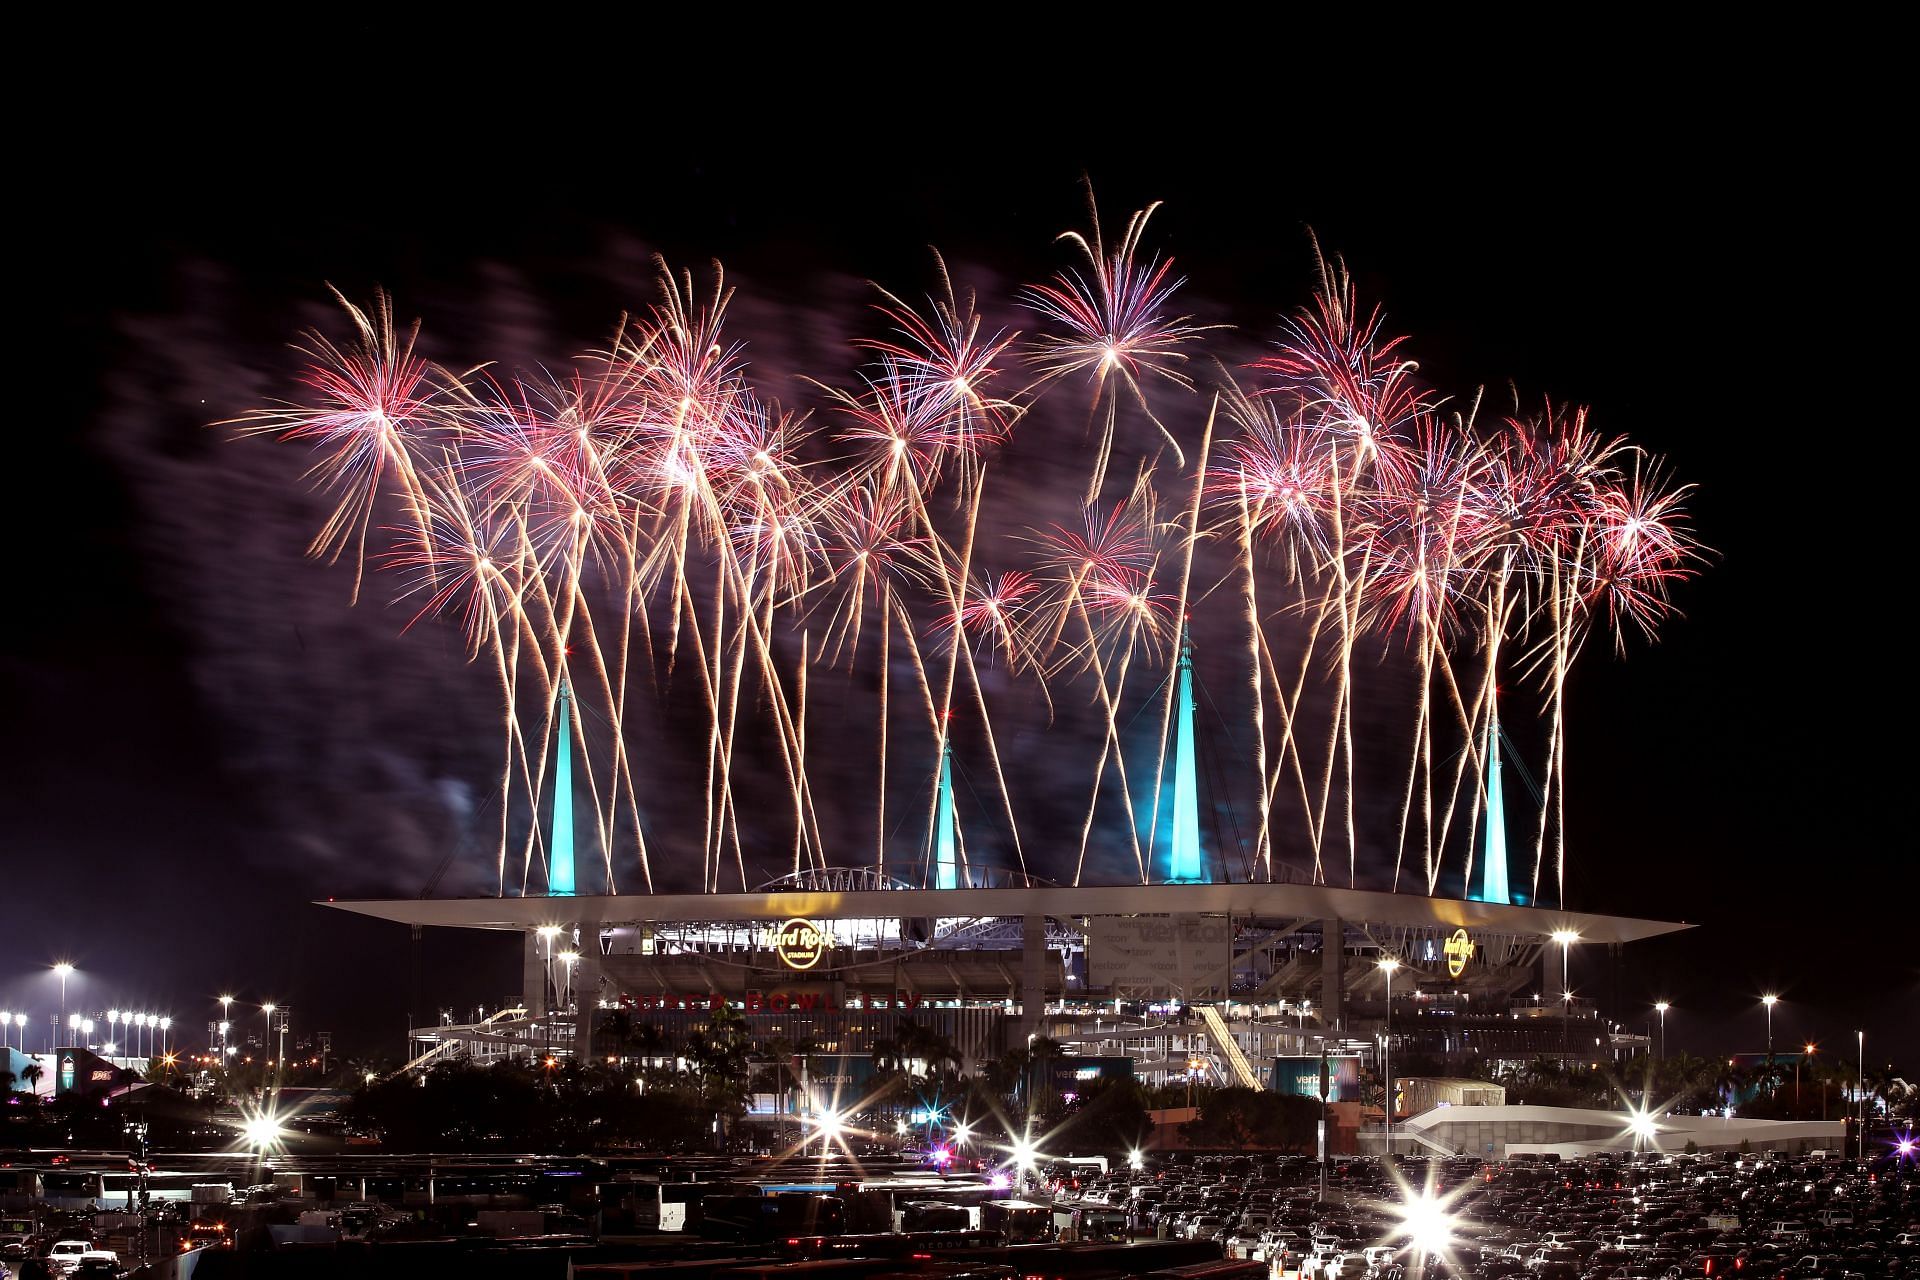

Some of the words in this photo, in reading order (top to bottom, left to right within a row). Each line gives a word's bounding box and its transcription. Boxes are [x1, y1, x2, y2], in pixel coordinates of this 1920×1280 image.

[762, 928, 798, 946] Hard
[800, 928, 836, 949] Rock
[787, 951, 815, 959] STADIUM
[746, 992, 838, 1014] BOWL
[862, 992, 922, 1014] LIV
[1056, 1069, 1096, 1080] verizon
[1296, 1073, 1335, 1083] verizn
